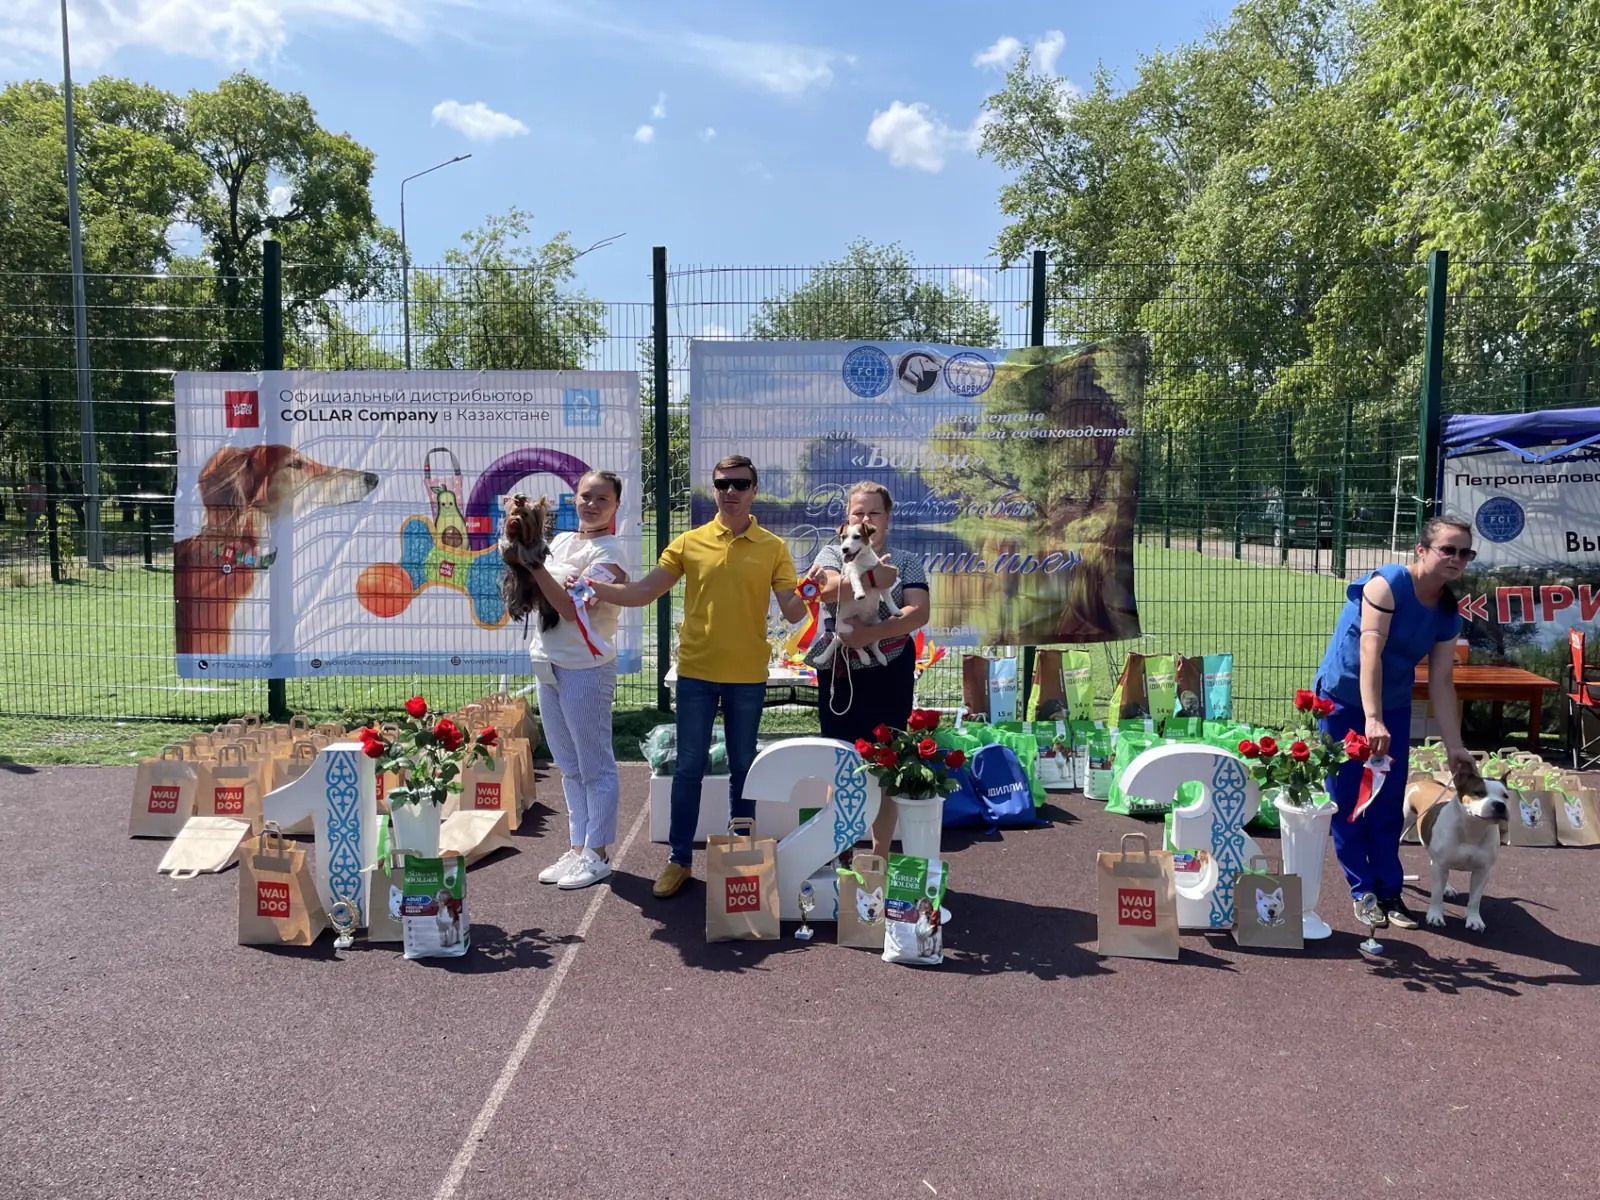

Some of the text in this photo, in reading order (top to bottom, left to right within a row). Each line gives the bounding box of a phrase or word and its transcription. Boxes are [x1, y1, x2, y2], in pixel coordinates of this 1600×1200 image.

[857, 369, 878, 377] FCI
[956, 383, 982, 395] БАРРИ
[280, 387, 534, 404] Официальный дистрибьютор
[281, 408, 550, 425] COLLAR Company в Казахстане
[1011, 424, 1136, 439] собаководства
[850, 445, 985, 473] «Барри»
[1490, 515, 1511, 524] FCI
[152, 790, 178, 799] WAU
[217, 792, 242, 800] WAU
[478, 787, 499, 796] WAU
[151, 800, 176, 809] DOG
[217, 801, 242, 810] DOG
[477, 797, 499, 805] DOG
[895, 874, 920, 883] GREEN
[728, 882, 757, 894] WAU
[890, 880, 921, 889] HOLDER
[259, 887, 287, 899] WAU
[260, 900, 288, 911] DOG
[728, 894, 757, 907] DOG
[1120, 895, 1153, 908] WAU
[1121, 908, 1153, 920] DOG
